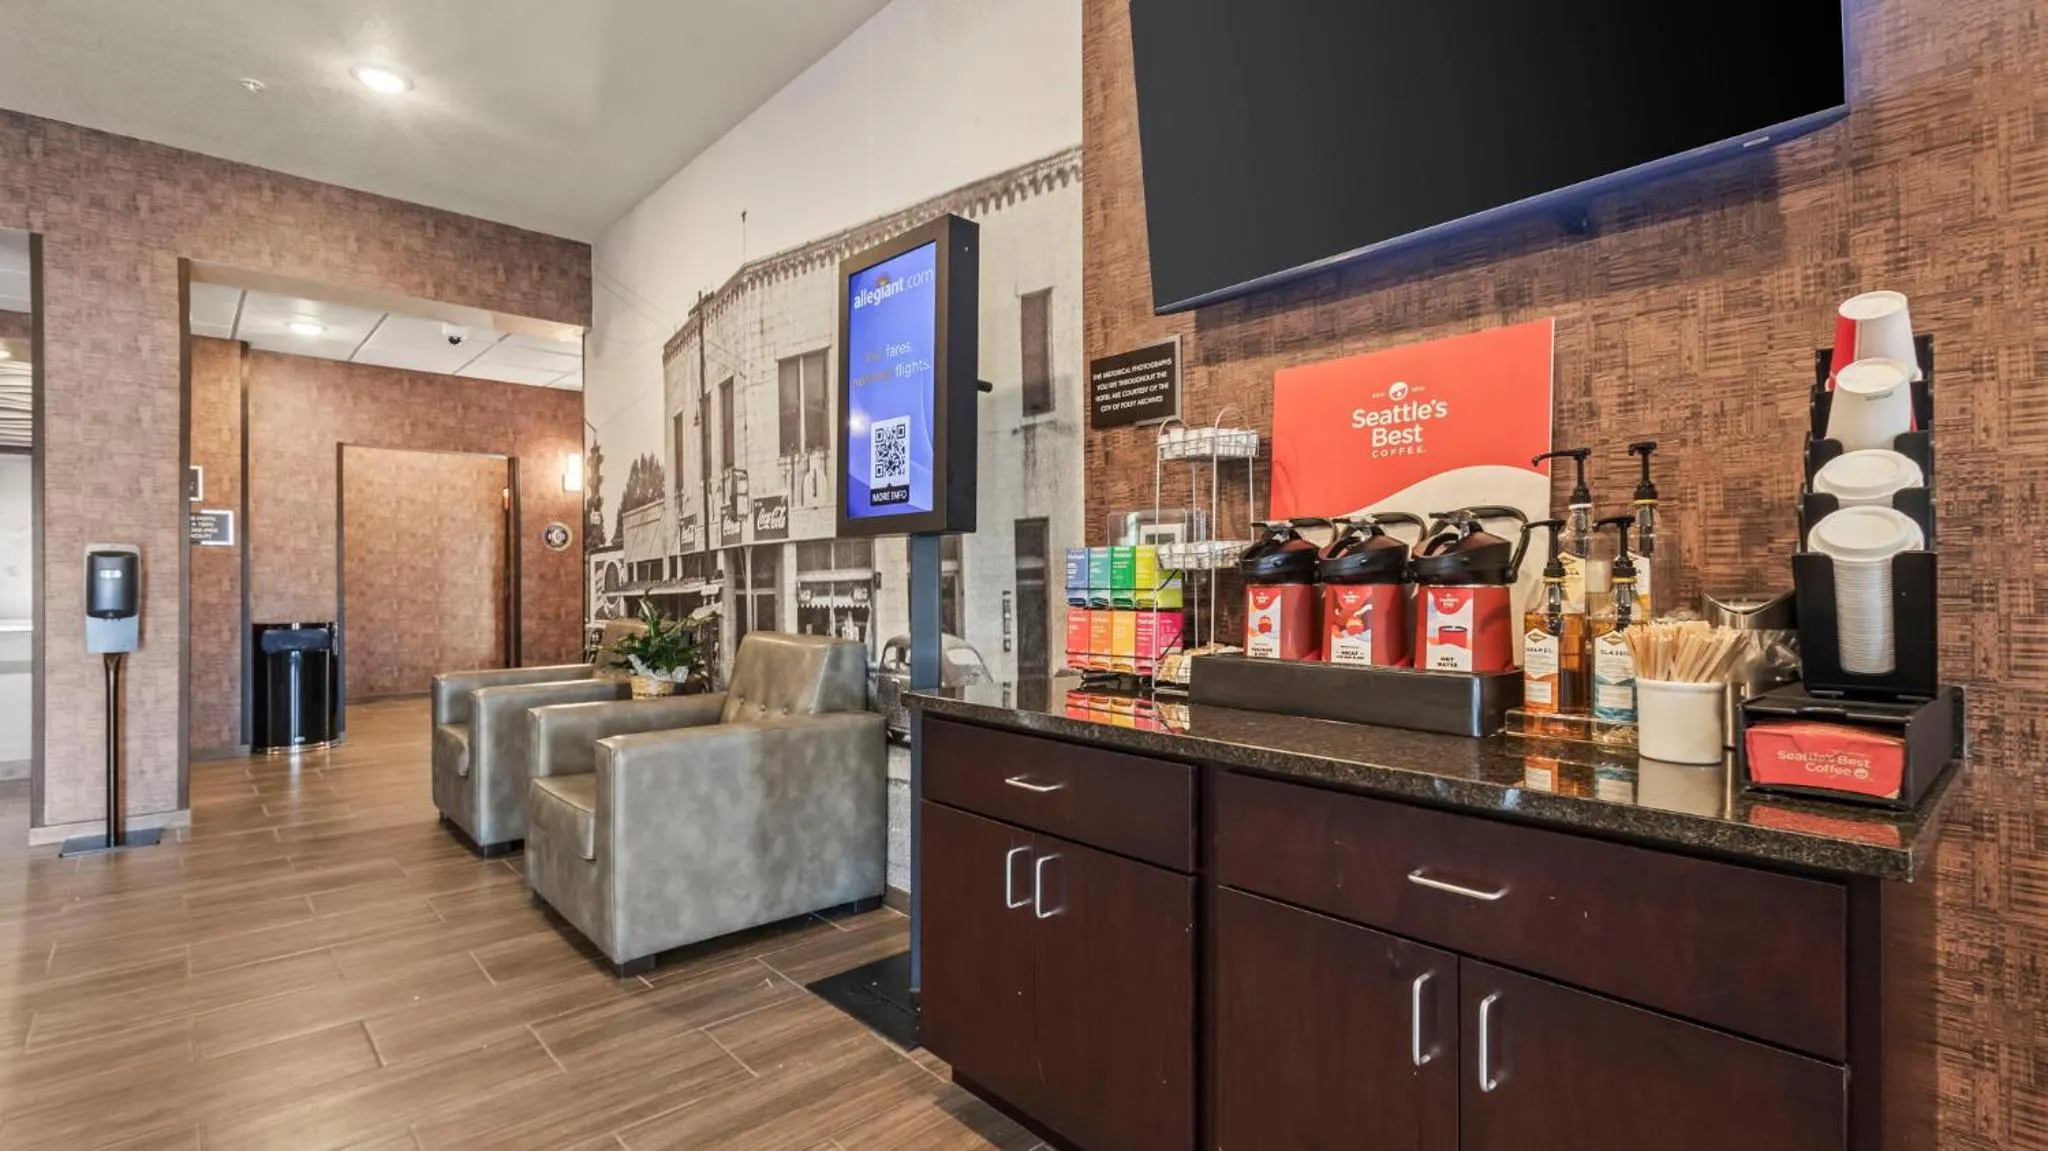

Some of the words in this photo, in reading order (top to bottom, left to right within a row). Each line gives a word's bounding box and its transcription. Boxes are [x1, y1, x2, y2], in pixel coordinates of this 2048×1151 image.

[854, 268, 934, 309] allegiant.com
[1352, 400, 1448, 428] Seattle's
[1372, 424, 1423, 447] Best
[1372, 445, 1423, 458] COFFEE
[872, 491, 891, 502] MORE
[891, 489, 907, 500] INFO
[1805, 762, 1851, 777] Coffee
[1837, 755, 1872, 769] Best
